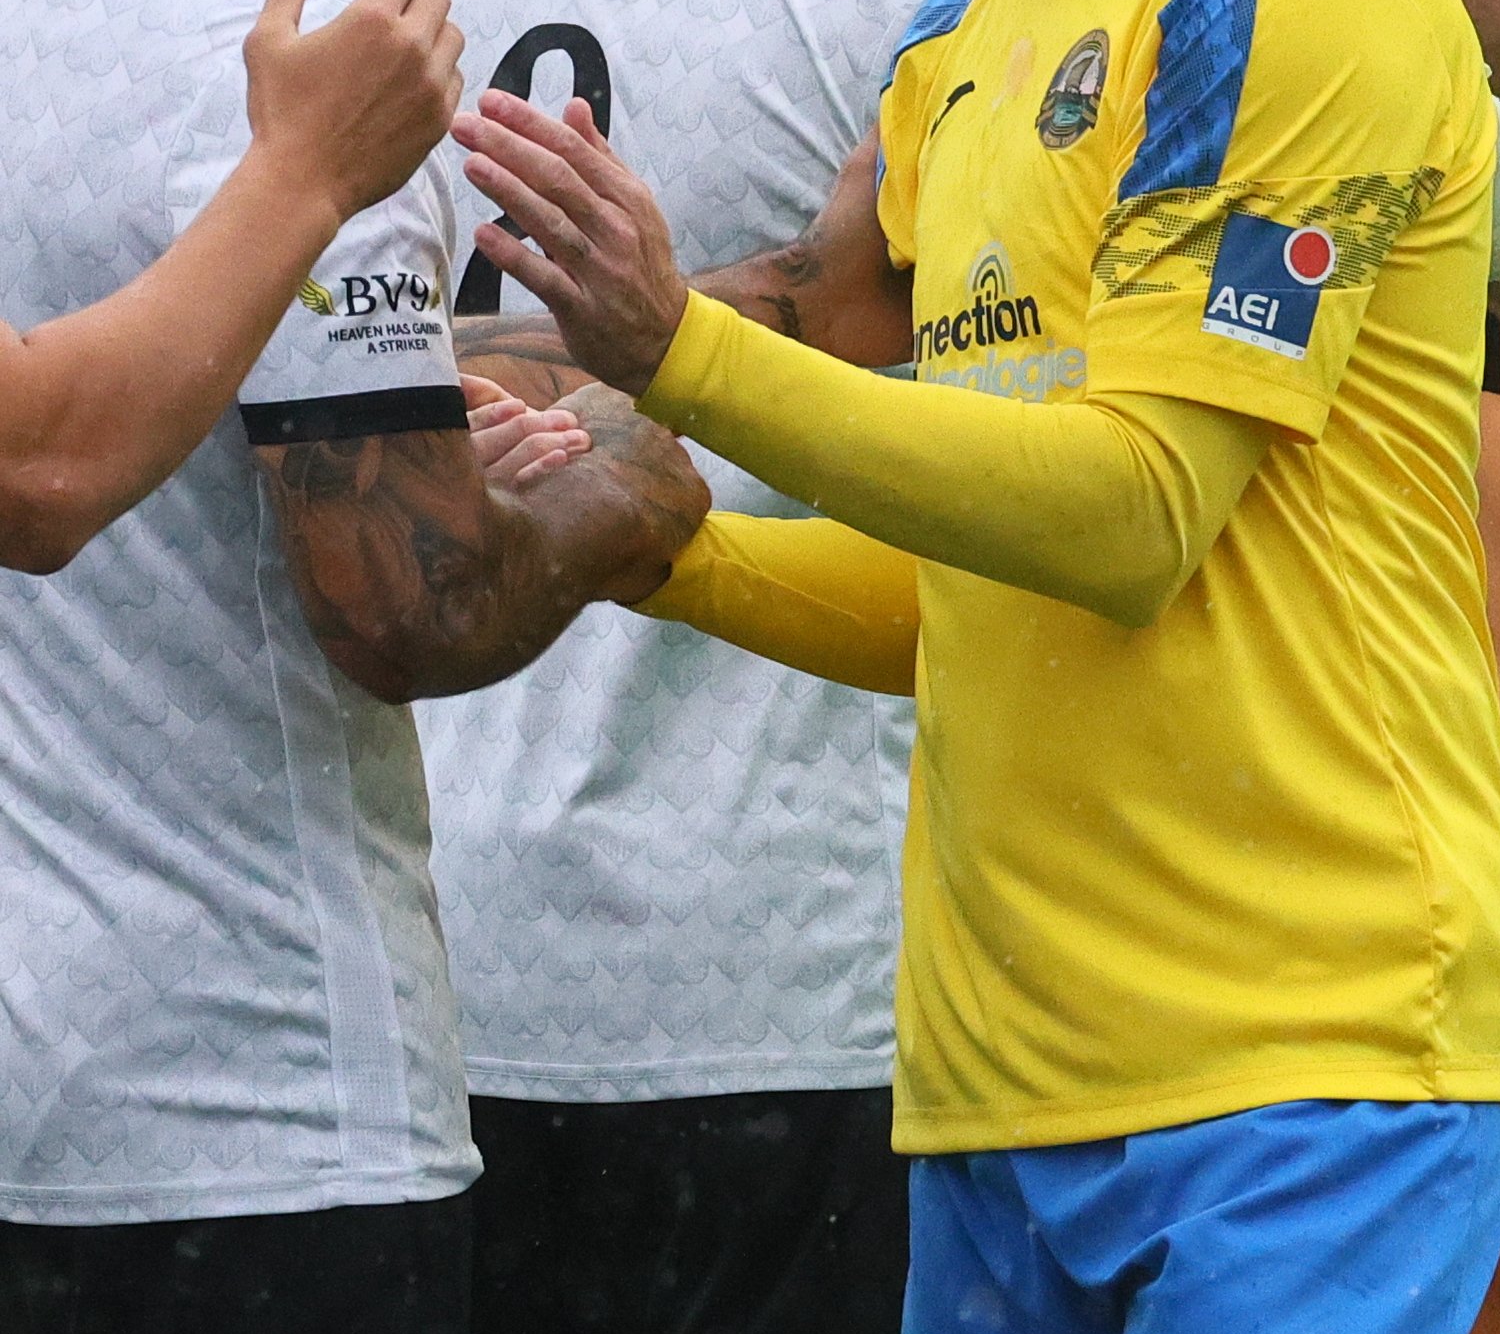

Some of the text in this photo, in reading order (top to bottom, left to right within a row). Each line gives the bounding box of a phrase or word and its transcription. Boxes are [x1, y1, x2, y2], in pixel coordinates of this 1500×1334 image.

[340, 272, 430, 317] BV9
[1207, 285, 1280, 331] AEI
[327, 324, 384, 343] HEAVEN
[386, 322, 411, 336] HAS
[367, 338, 430, 355] A STRIKER
[914, 290, 1042, 364] nection
